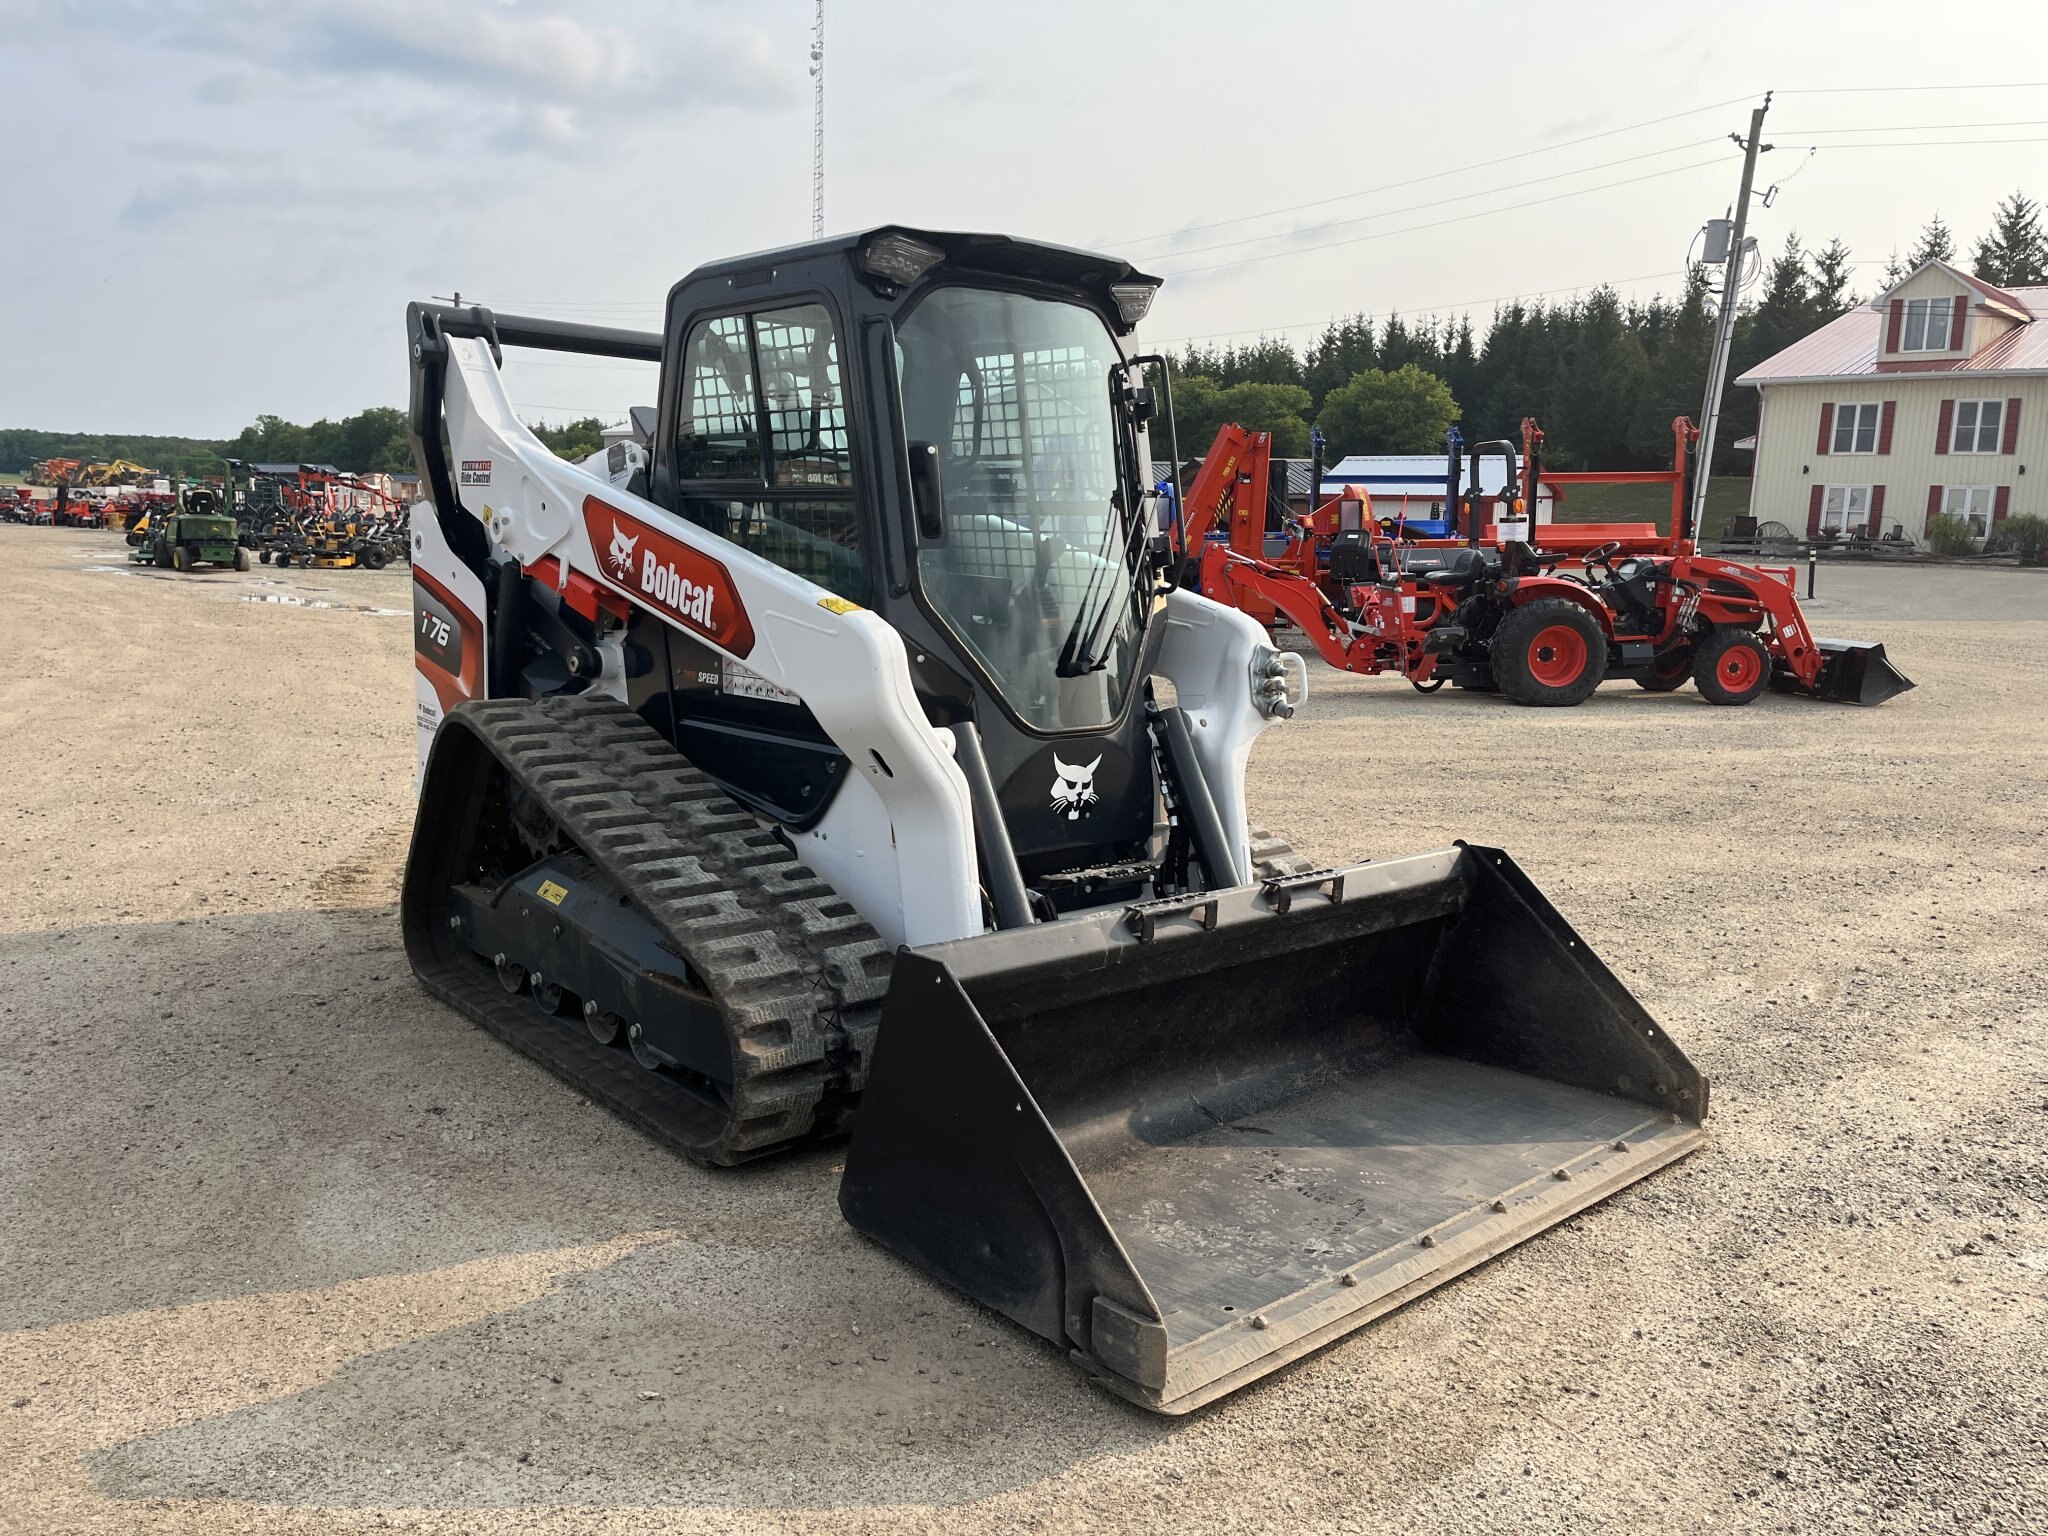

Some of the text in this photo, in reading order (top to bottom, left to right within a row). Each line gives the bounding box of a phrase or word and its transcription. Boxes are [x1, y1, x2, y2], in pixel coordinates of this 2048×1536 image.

[462, 462, 490, 470] AUTOMATIC
[461, 472, 491, 484] Ride Control
[641, 549, 714, 629] Bobcat
[697, 671, 719, 685] SPEED
